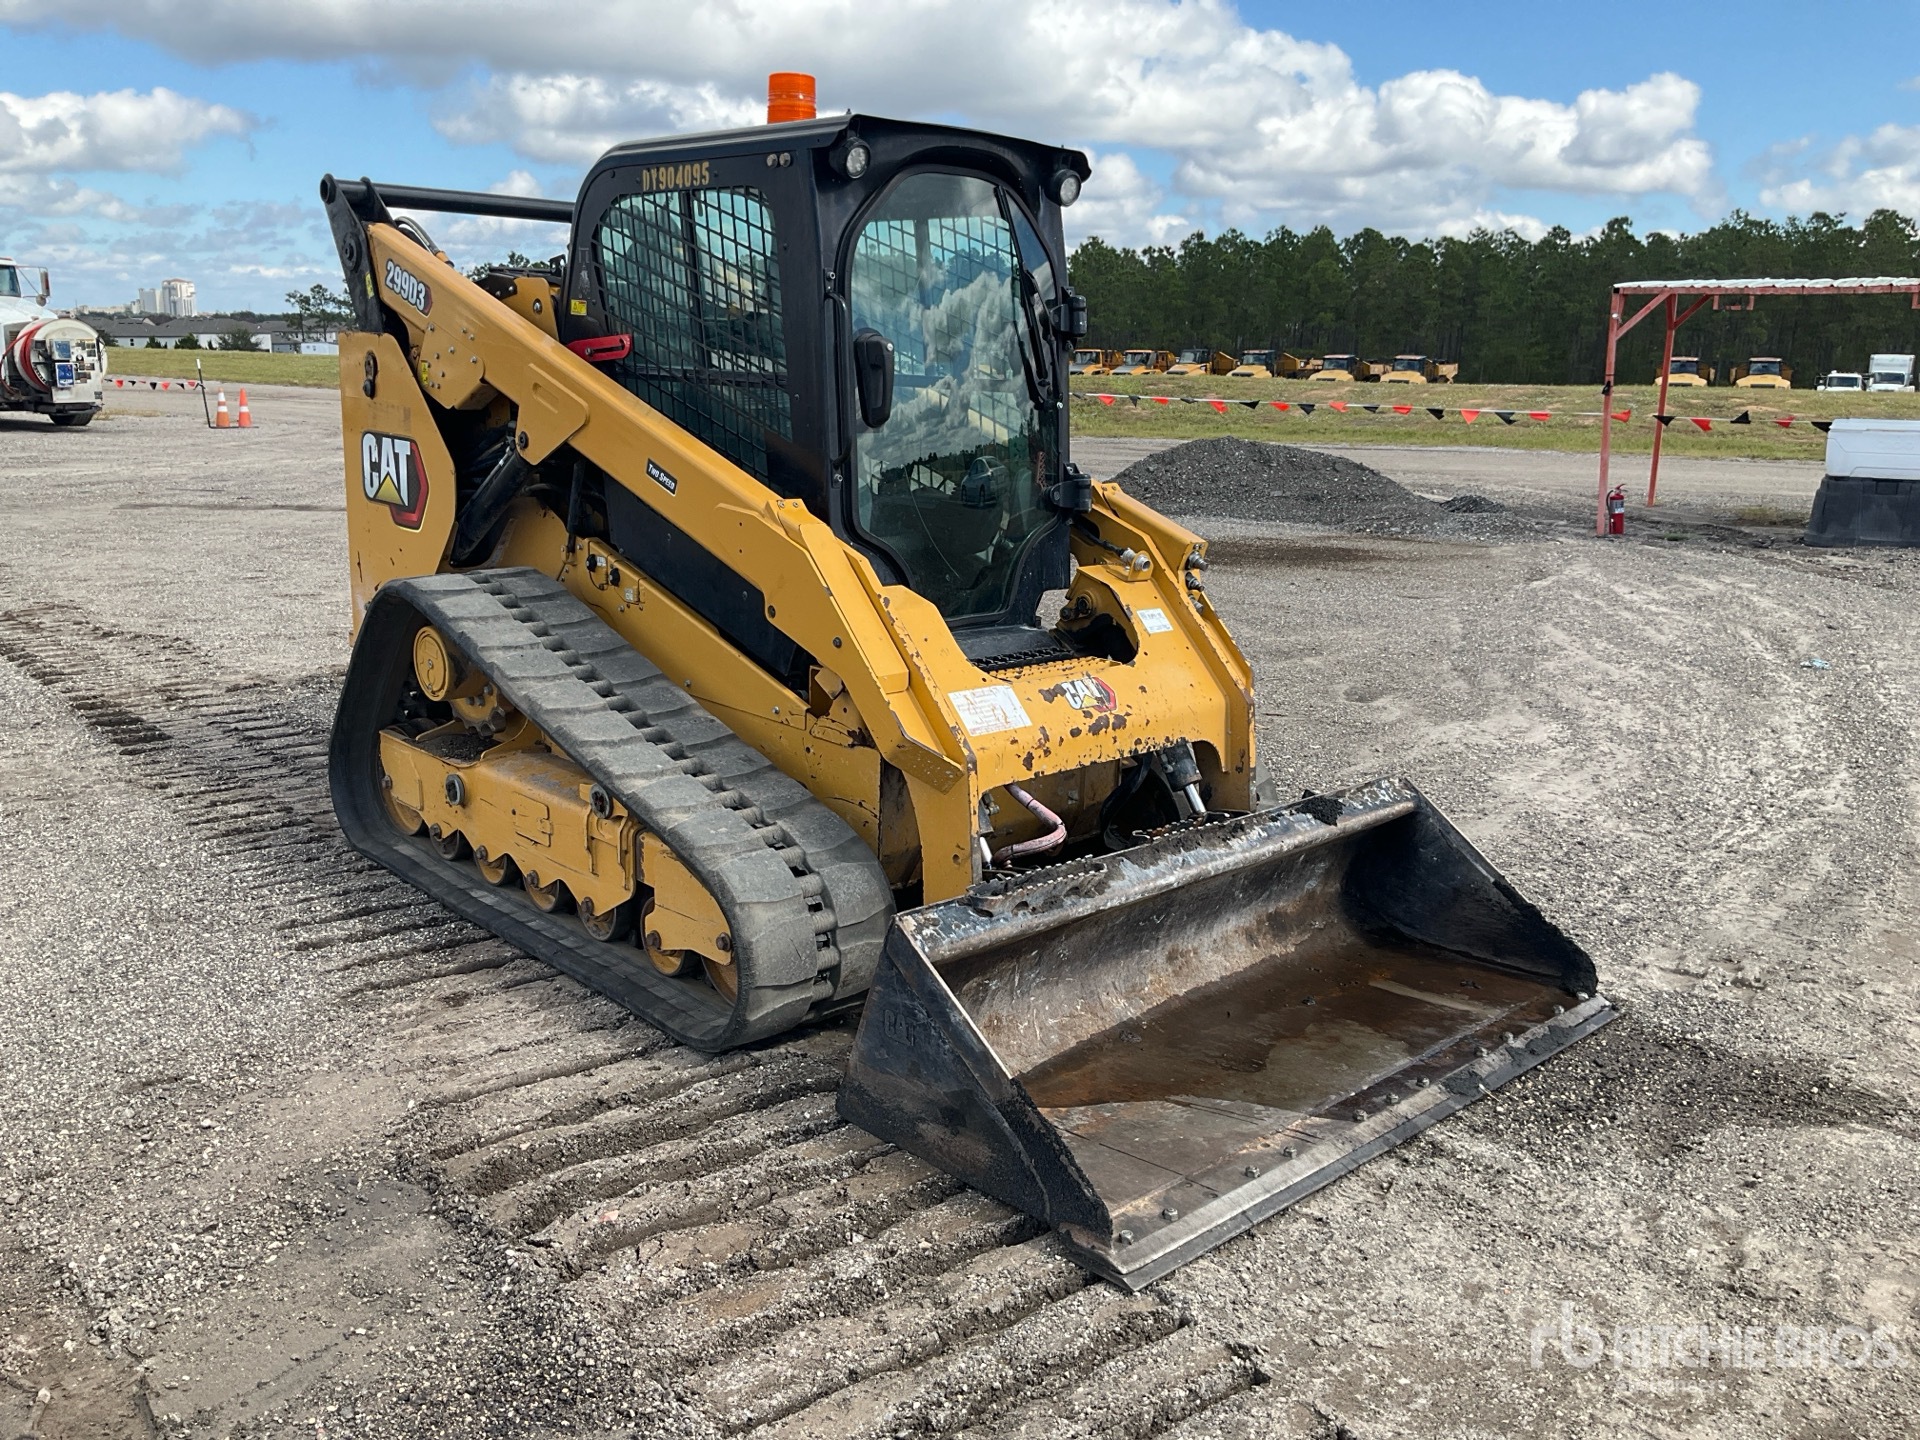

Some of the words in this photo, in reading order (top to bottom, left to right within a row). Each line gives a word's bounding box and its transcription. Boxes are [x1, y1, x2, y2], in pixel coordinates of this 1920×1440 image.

[642, 161, 710, 191] DY904095
[385, 259, 427, 311] 299D3
[362, 432, 411, 507] CAT
